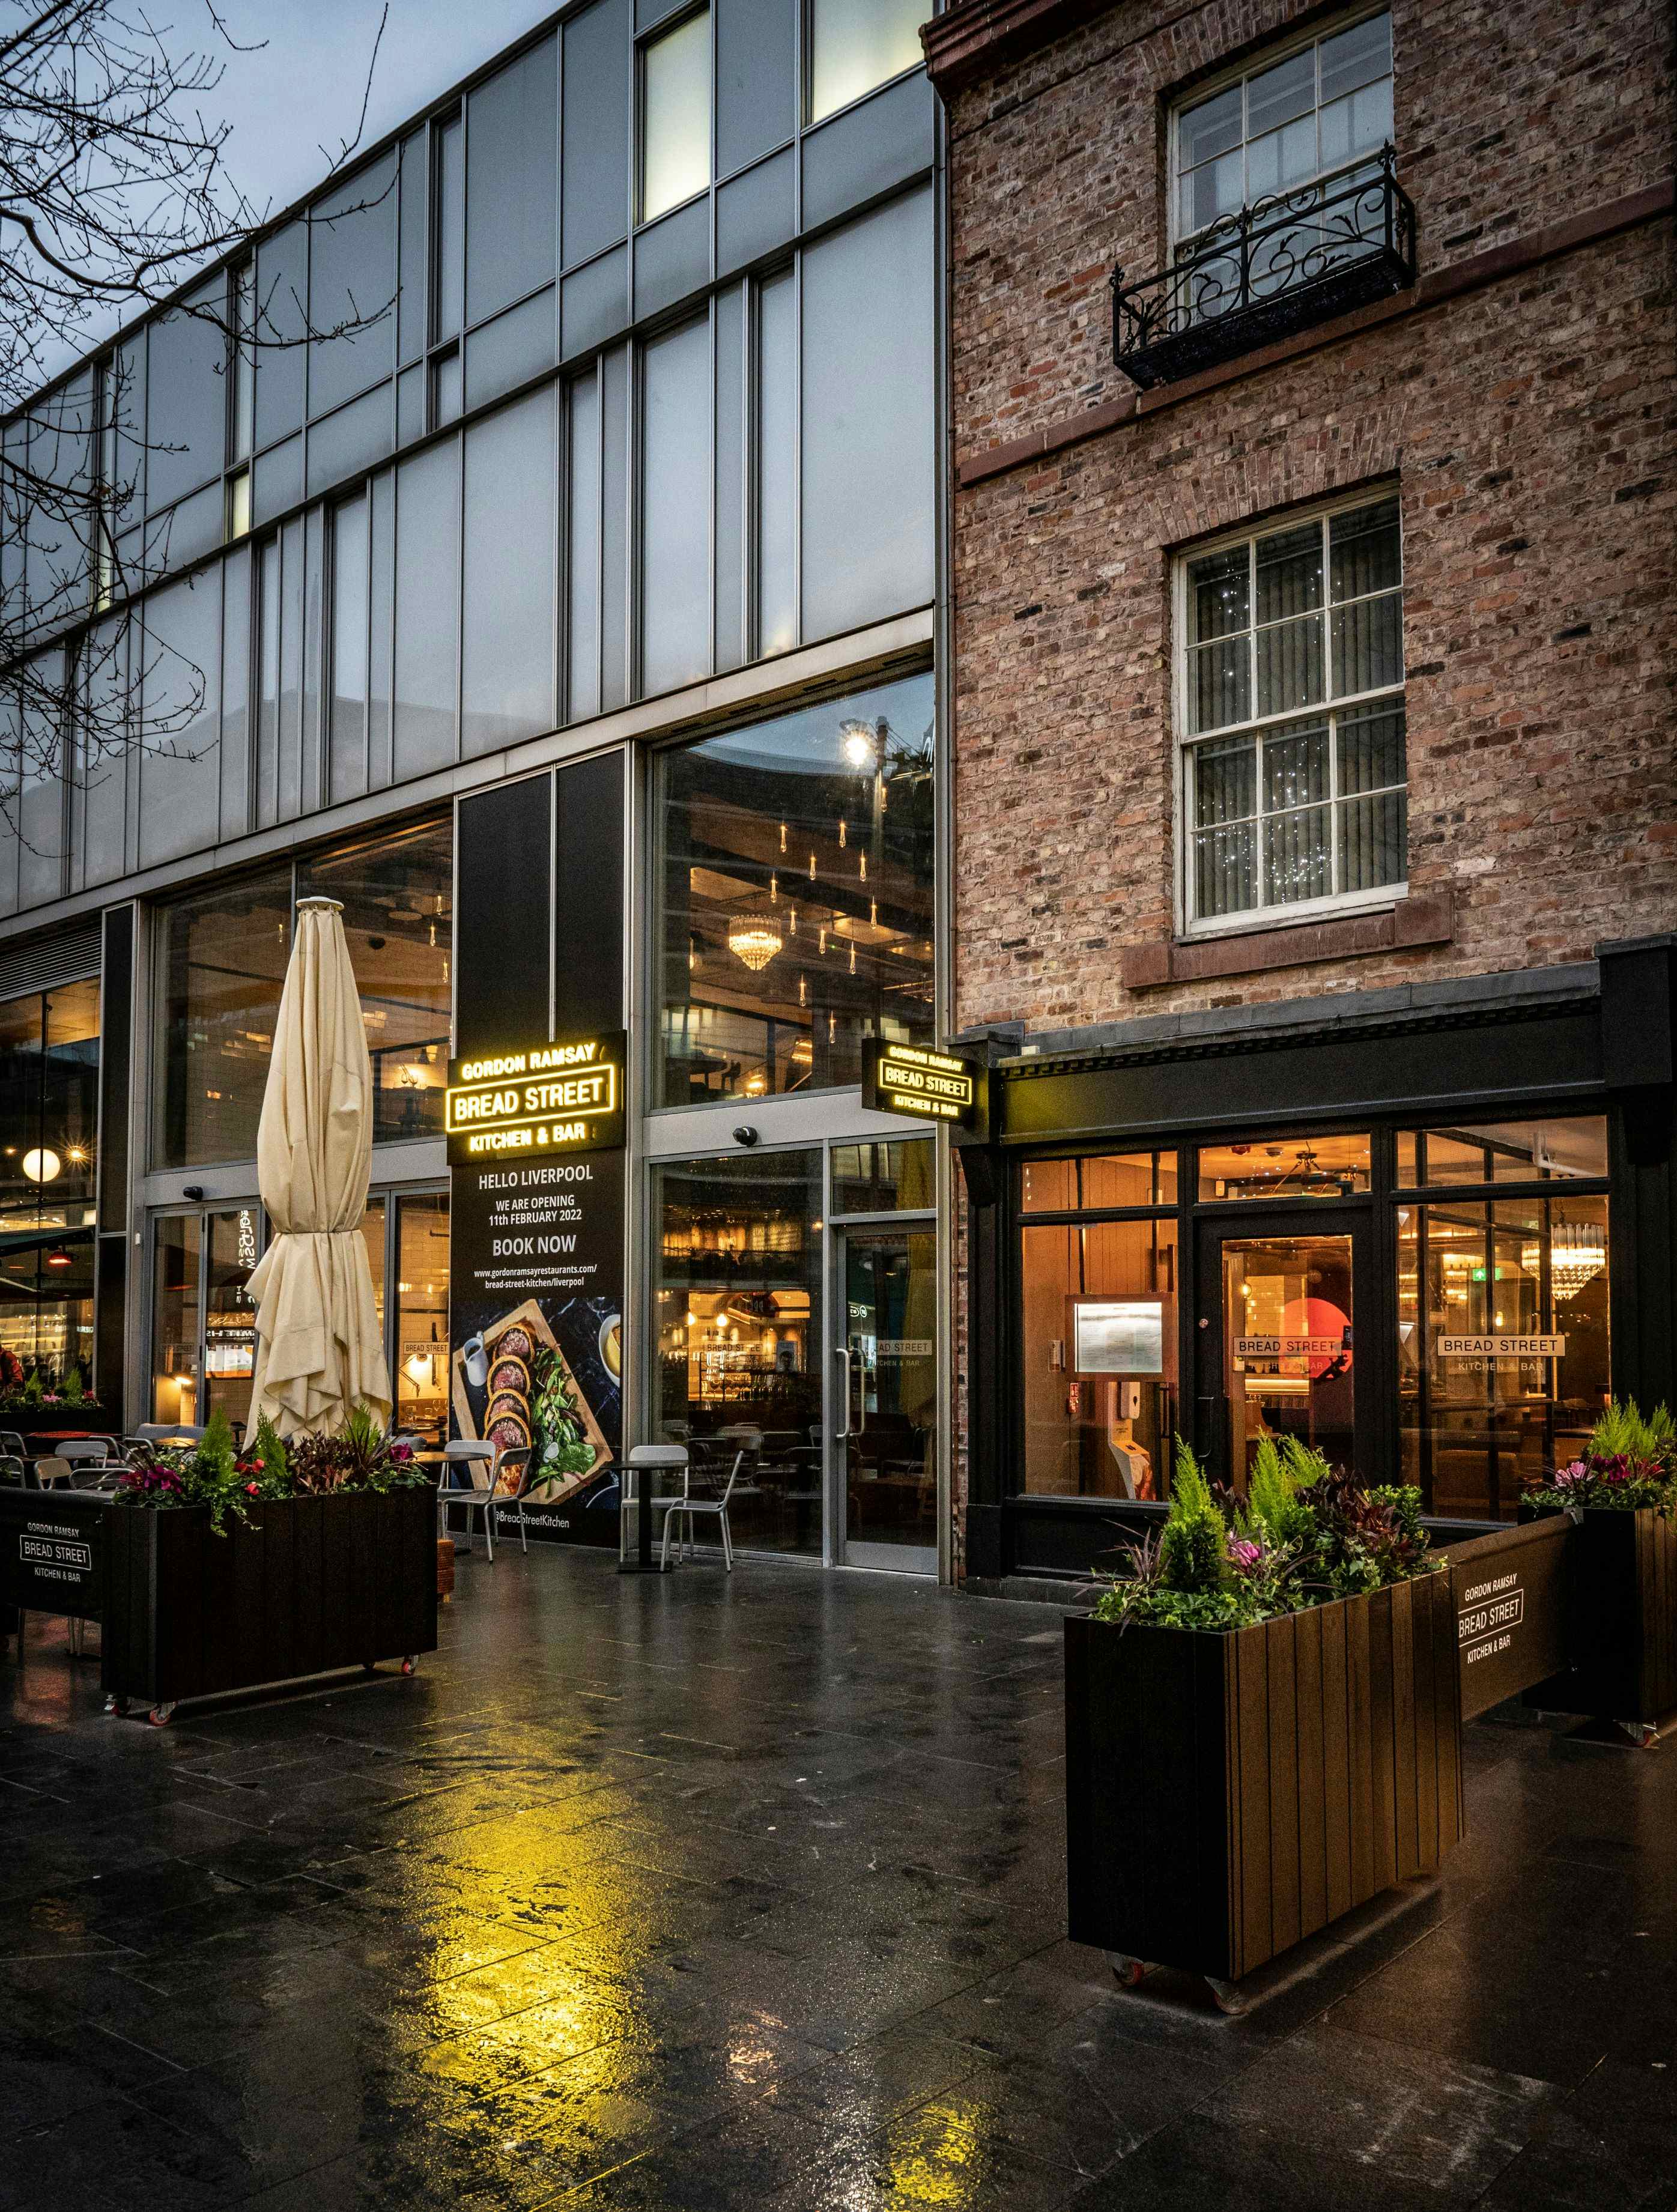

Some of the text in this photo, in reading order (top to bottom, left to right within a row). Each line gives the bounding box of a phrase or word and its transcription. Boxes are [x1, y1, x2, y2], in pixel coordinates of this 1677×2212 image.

[462, 1042, 596, 1080] GORDON RAMSAY
[890, 1046, 928, 1064] GORDON
[885, 1067, 966, 1097] BREAD STREET
[455, 1077, 603, 1121] BREAD STREET
[894, 1095, 959, 1117] KITCHEN & BAR
[470, 1122, 585, 1152] KITCHEN & BAR
[479, 1165, 593, 1190] HELLO LIVERPOOL
[496, 1195, 574, 1211] WE ARE OPENING
[489, 1209, 582, 1226] 11th FEBRUARY 2022
[493, 1234, 577, 1256] BOOK NOW
[474, 1264, 597, 1279] www.gordonramsayrestaurants.com/
[485, 1277, 584, 1289] bread-street-kitchen/liverpool
[894, 1343, 928, 1351] STREET
[1239, 1341, 1335, 1351] BREAD STREET
[1444, 1340, 1557, 1351] BREAD STREET
[28, 1523, 79, 1538] GORDON RAMSAY
[25, 1542, 86, 1563] BREAD STREET
[34, 1566, 80, 1583] KITCHEN & BAR
[1465, 1573, 1517, 1601] GORDON RAMSAY
[1459, 1598, 1520, 1638] BREAD STREET
[1467, 1634, 1511, 1664] KITCHEN & BAR
